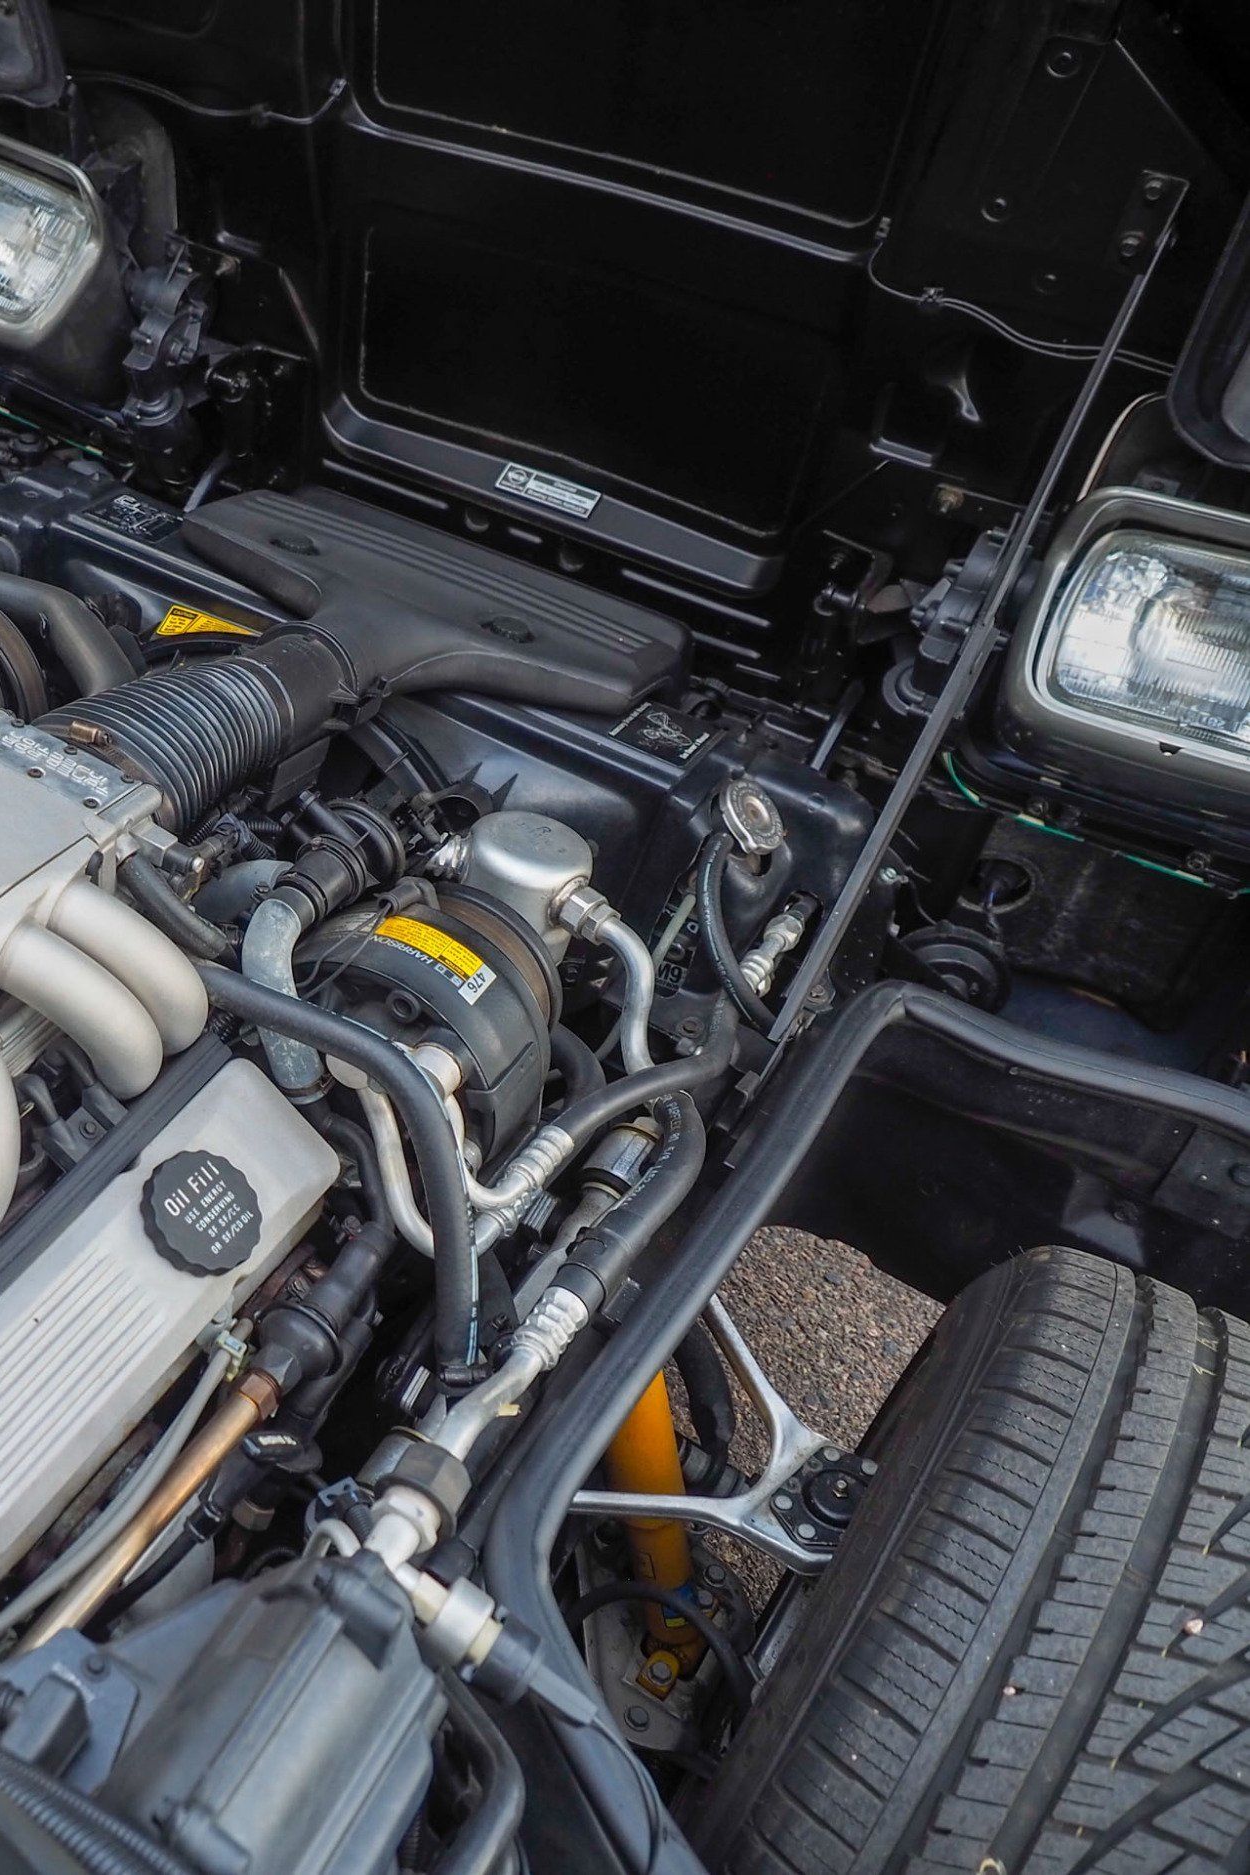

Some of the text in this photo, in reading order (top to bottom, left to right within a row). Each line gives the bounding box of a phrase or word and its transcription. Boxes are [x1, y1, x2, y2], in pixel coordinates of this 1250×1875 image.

[370, 935, 434, 967] HARRISON
[448, 961, 464, 975] CAUTION
[467, 972, 485, 993] 476
[163, 1160, 219, 1216] Oil Fill
[184, 1179, 227, 1224] USE ENERGY
[195, 1191, 235, 1232] CONSERVING
[220, 1203, 242, 1227] SF/CC
[211, 1210, 254, 1255] OR SF/CD OIL
